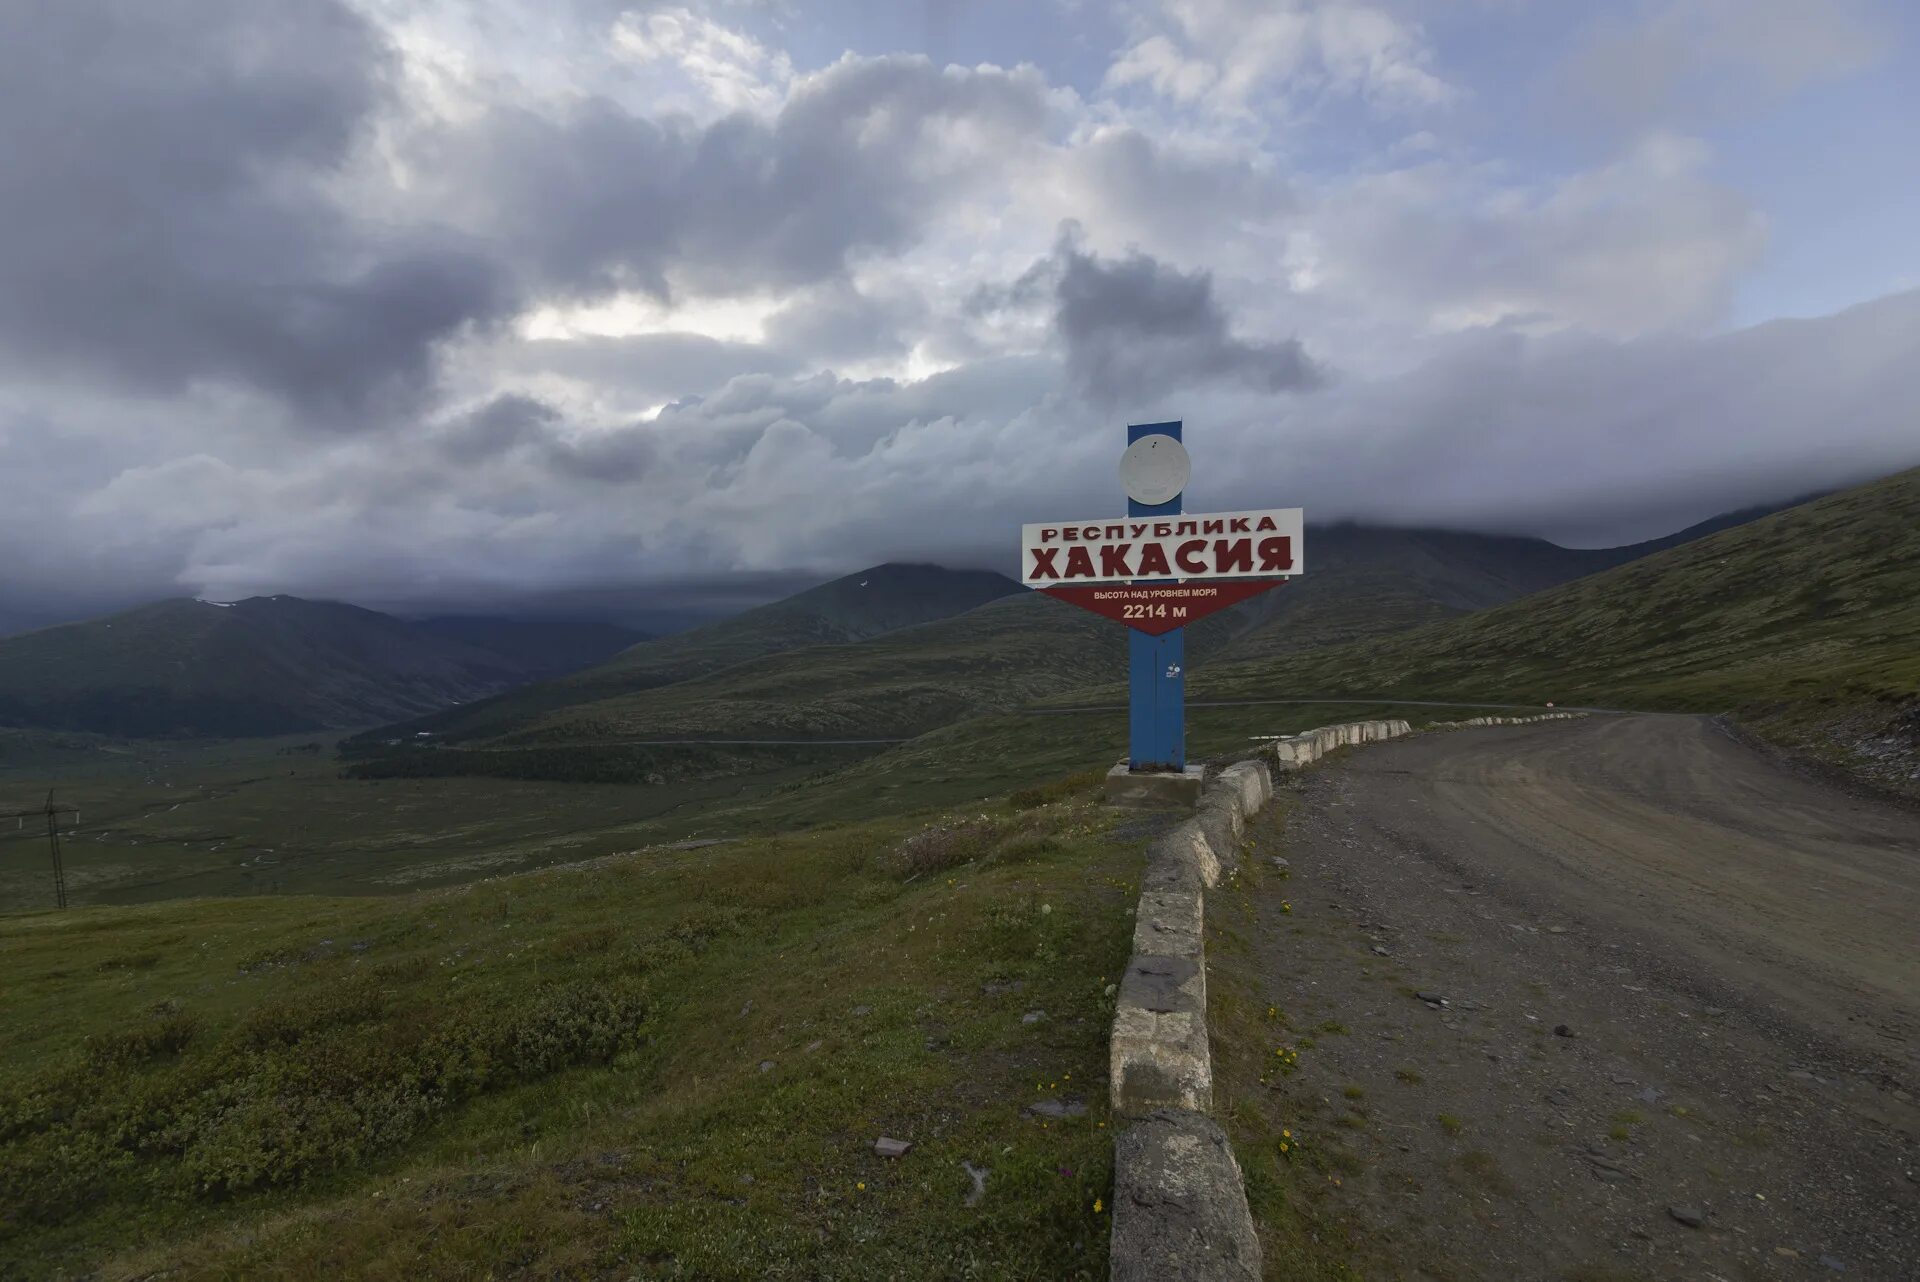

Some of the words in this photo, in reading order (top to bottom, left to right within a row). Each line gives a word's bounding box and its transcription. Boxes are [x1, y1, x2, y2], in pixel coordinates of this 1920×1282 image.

[1041, 516, 1278, 543] РЕСПУБЛИКА
[1029, 536, 1294, 580] ХАКАСИЯ
[1094, 591, 1129, 600] ВЫСОТА
[1131, 590, 1148, 599] НАД
[1150, 589, 1190, 598] УРОВНЕМ
[1192, 588, 1217, 597] МОРЯ
[1123, 604, 1166, 619] 2214
